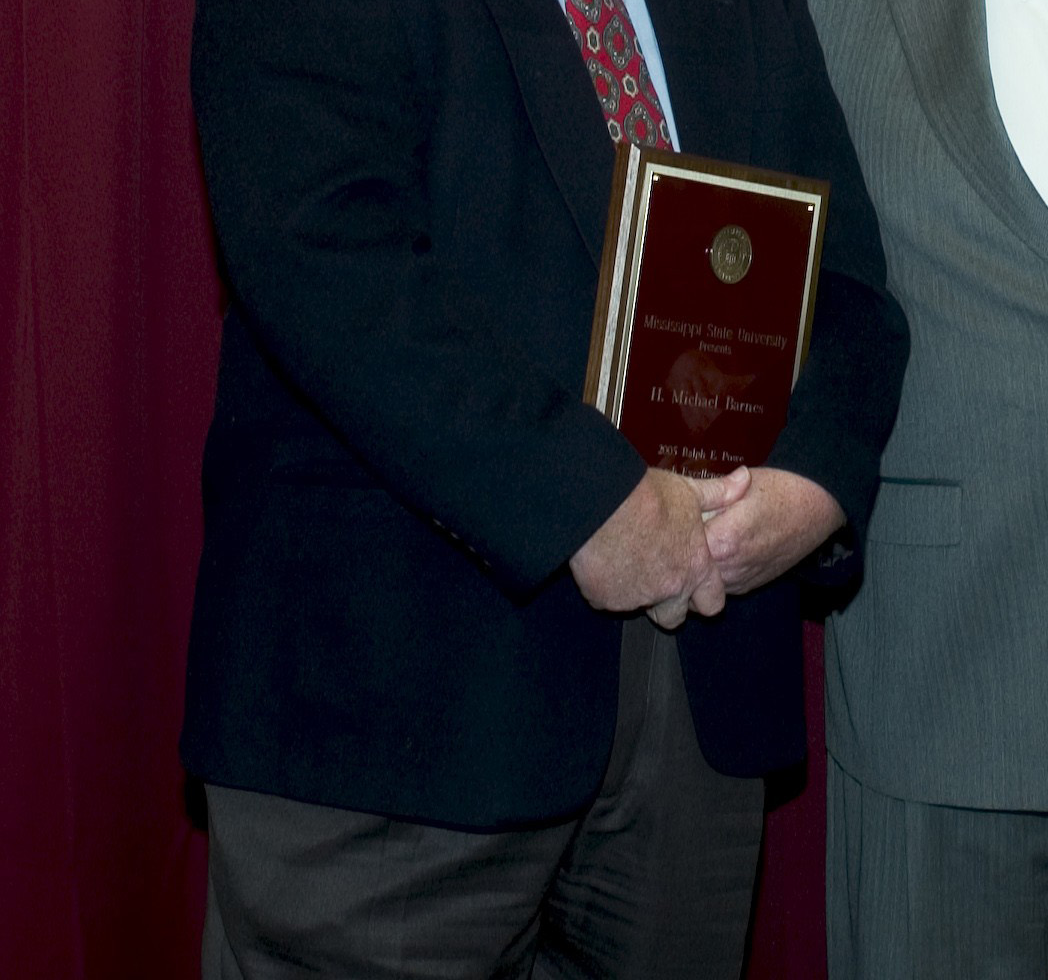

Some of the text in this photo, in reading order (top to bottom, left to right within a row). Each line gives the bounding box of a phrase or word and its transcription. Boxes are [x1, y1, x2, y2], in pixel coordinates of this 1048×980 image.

[644, 314, 788, 350] Mississippi State University
[699, 341, 732, 355] Presents
[650, 386, 764, 414] H. Michael Barnes
[657, 444, 678, 456] 2005
[682, 446, 706, 460] Ralph
